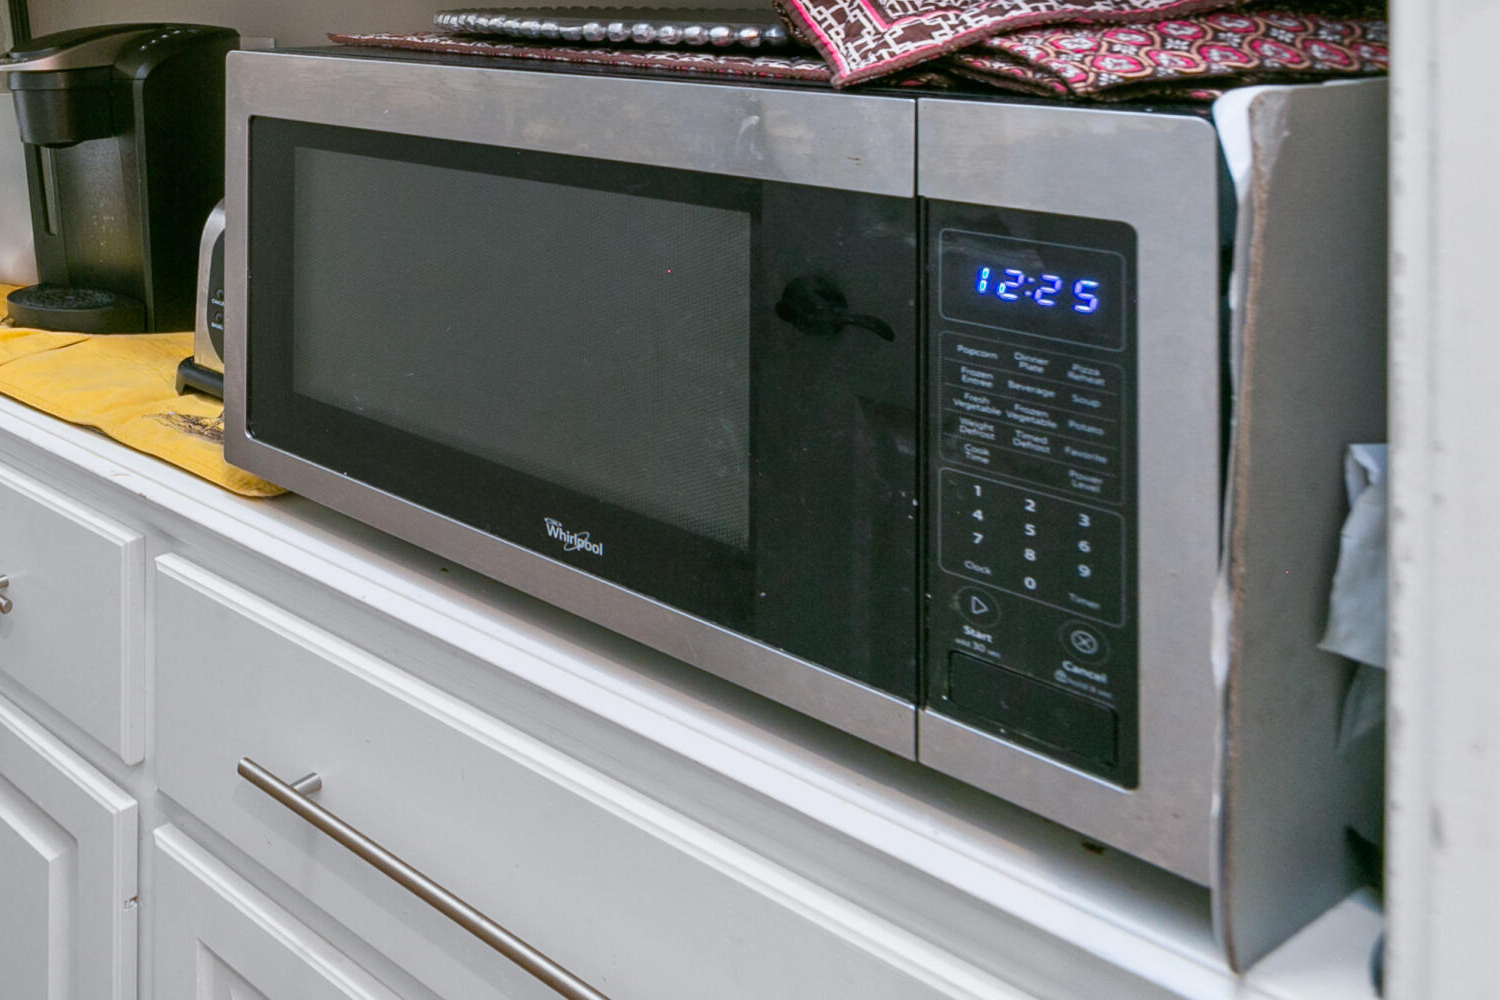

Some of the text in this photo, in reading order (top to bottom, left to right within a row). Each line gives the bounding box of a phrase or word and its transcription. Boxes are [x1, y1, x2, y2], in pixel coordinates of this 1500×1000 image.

[976, 267, 1100, 314] 12:25
[956, 344, 998, 360] Popcorn
[1014, 352, 1049, 366] Dinner
[960, 366, 994, 380] Frozen
[1019, 360, 1045, 374] Plate
[1071, 363, 1101, 377] Pizza
[961, 374, 993, 388] Entree
[1067, 370, 1106, 386] Reheat
[1007, 380, 1056, 398] Beverage
[963, 392, 990, 405] Fresh
[1071, 393, 1101, 408] Soup
[952, 398, 1002, 416] Vegetable
[1013, 403, 1049, 418] Frozen
[959, 417, 995, 432] Weight
[1006, 410, 1058, 429] Vegetable
[959, 425, 996, 440] Defrost
[1067, 420, 1105, 436] Potato
[1015, 429, 1049, 445] Timed
[964, 443, 990, 457] Cook
[1012, 437, 1051, 454] Defrost
[964, 451, 990, 464] Time
[1063, 446, 1108, 464] Favorite
[1068, 469, 1103, 486] Power
[973, 485, 982, 497] 1
[1071, 480, 1102, 494] Level
[1023, 499, 1036, 512] 2
[972, 509, 984, 521] 4
[1078, 513, 1091, 527] 3
[544, 518, 603, 556] Whirlpool
[1024, 523, 1037, 537] 5
[972, 532, 984, 545] 7
[1078, 540, 1091, 553] 6
[1023, 548, 1037, 562] 8
[963, 560, 992, 575] Clock
[1078, 564, 1091, 578] 9
[1023, 577, 1037, 590] 0
[1068, 592, 1102, 610] Timer
[963, 625, 994, 643] Start
[971, 641, 987, 653] 30
[1062, 660, 1108, 684] Cancel
